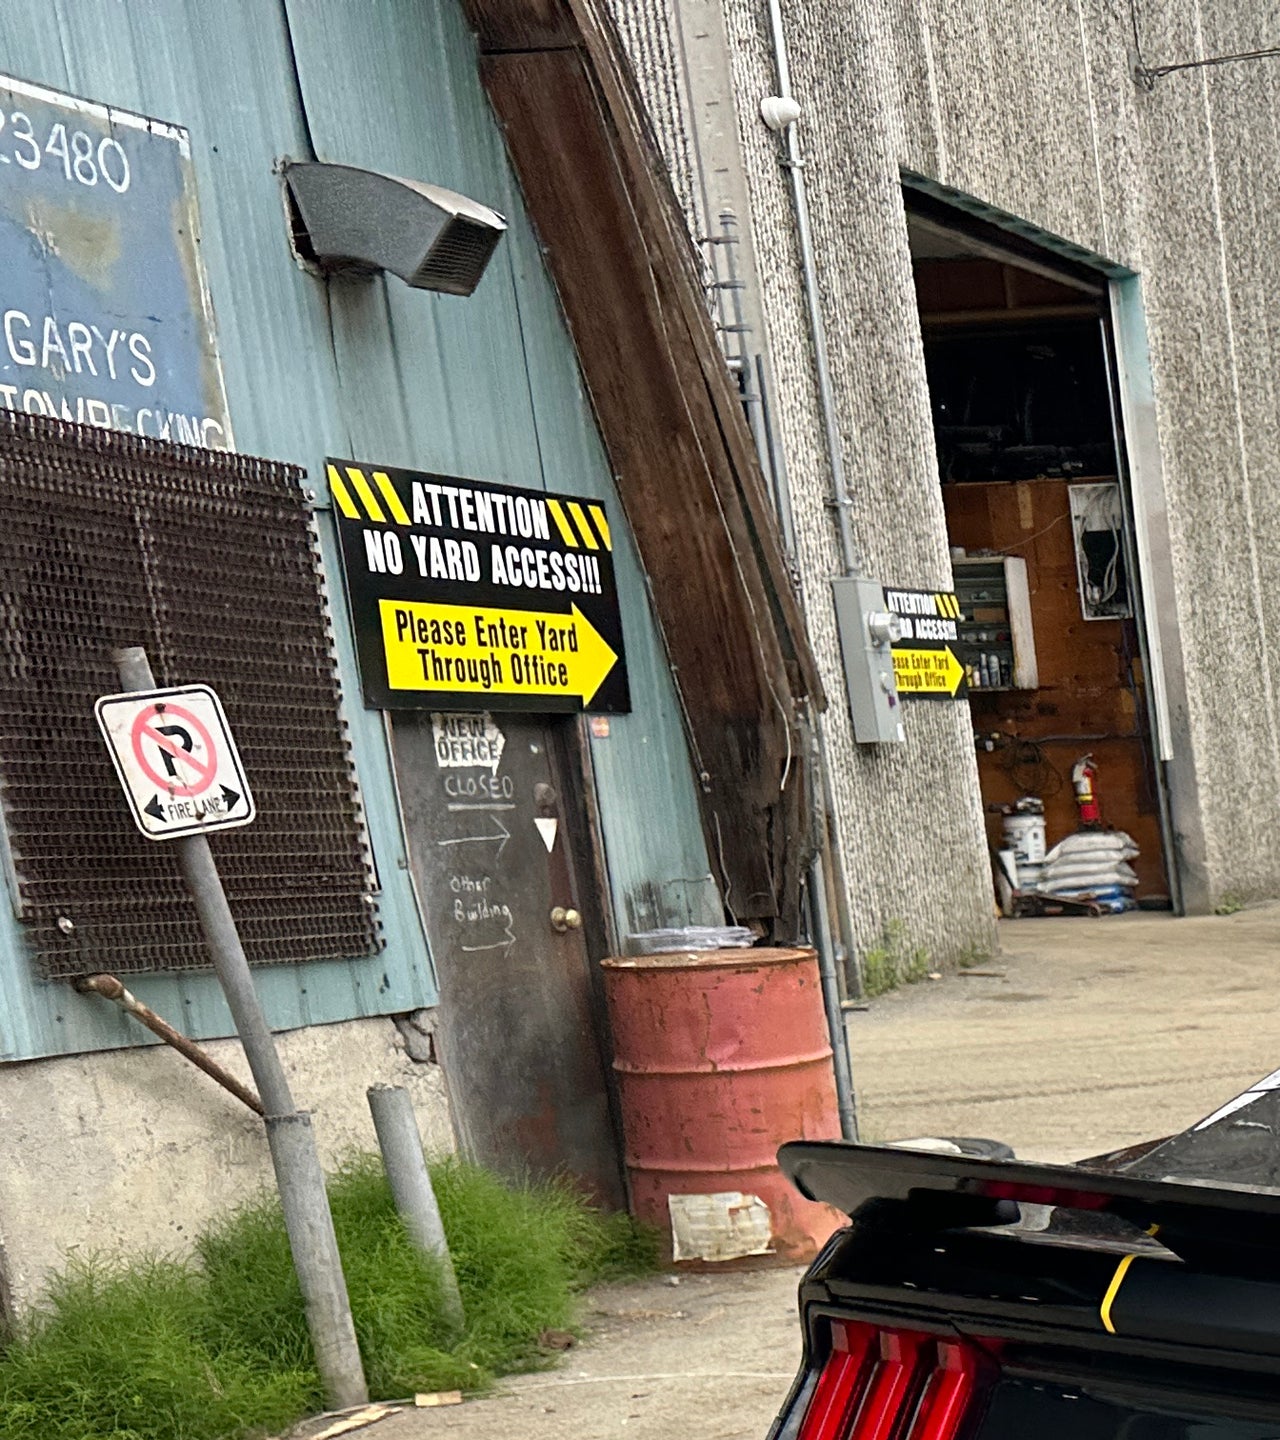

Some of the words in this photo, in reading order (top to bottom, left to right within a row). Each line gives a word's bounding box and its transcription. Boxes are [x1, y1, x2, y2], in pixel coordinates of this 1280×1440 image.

[3, 310, 156, 387] GARY'S
[411, 481, 550, 540] ATTENTION
[363, 529, 403, 575] NO
[410, 534, 481, 582] YARD
[491, 544, 602, 595] ACCESS!!!
[887, 591, 938, 615] ATTENTION
[395, 609, 467, 647] Please
[473, 615, 528, 650] Enter
[535, 619, 579, 652] Yard
[915, 618, 958, 641] ACCESS!!!
[417, 648, 502, 689] Through
[511, 653, 569, 687] Office
[893, 655, 910, 670] ease
[912, 654, 931, 670] Enter
[934, 655, 950, 671] Yard
[925, 672, 947, 687] Office
[443, 717, 486, 738] NEW
[438, 738, 499, 761] OFFICE
[445, 775, 514, 799] CLOSED
[167, 801, 194, 821] FIRE
[193, 797, 223, 818] LANE
